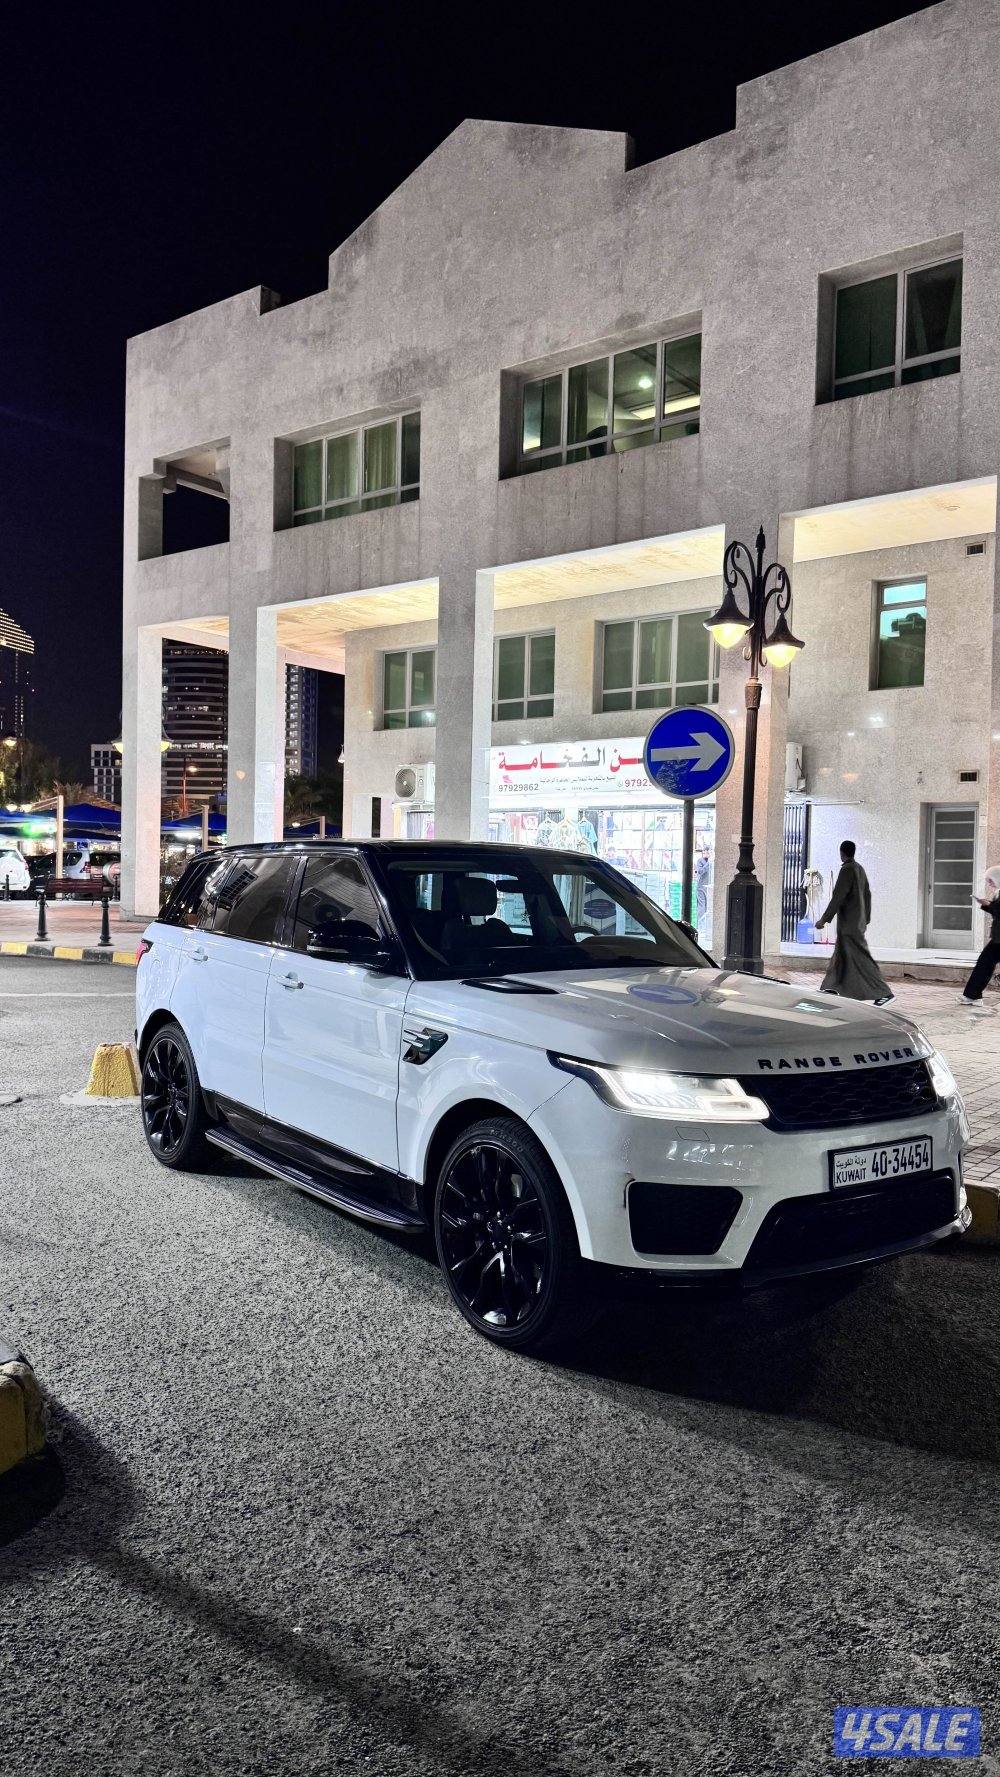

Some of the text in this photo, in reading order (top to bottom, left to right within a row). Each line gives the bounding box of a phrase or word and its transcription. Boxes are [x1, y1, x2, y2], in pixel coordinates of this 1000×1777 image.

[498, 746, 606, 771] الفخامة
[498, 783, 539, 792] 97929862
[757, 1047, 915, 1071] RANGE ROVER
[835, 1155, 867, 1169] دولة الكويت
[835, 1167, 867, 1184] KUWAIT
